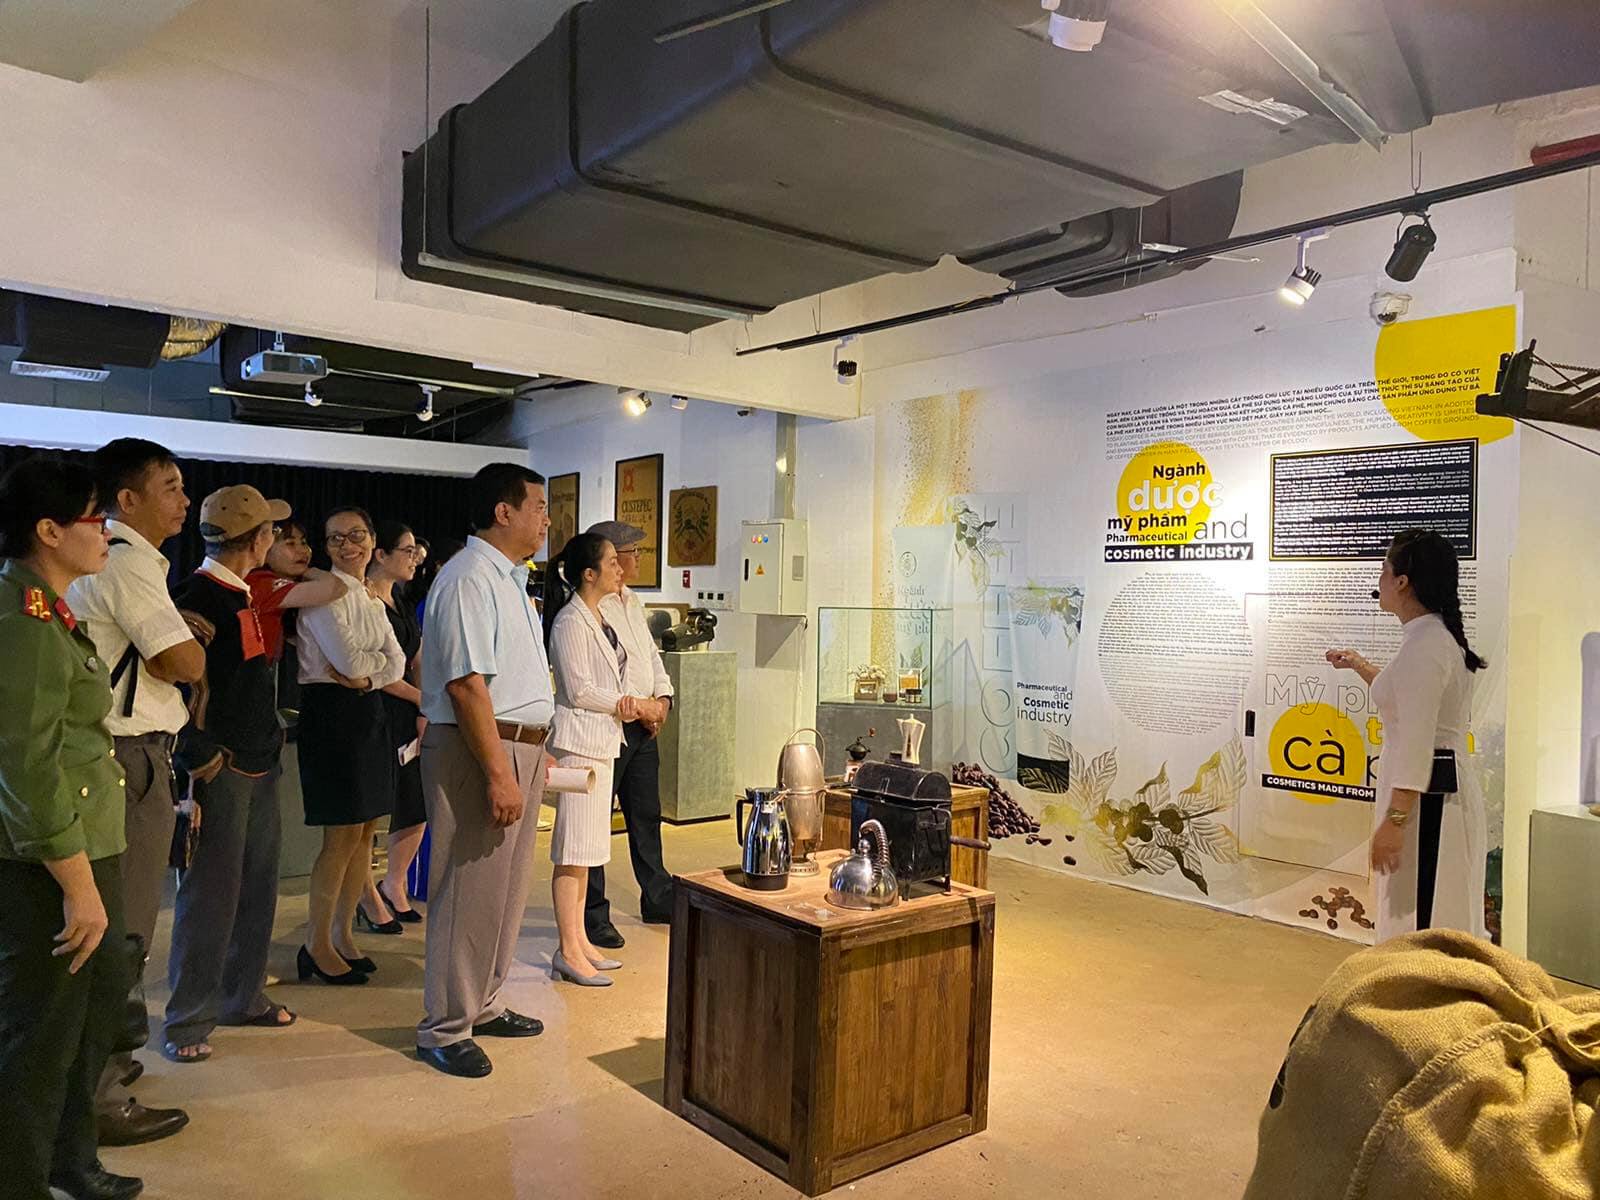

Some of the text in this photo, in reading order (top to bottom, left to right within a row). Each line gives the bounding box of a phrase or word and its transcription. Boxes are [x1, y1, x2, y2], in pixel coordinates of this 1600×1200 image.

[1444, 399, 1475, 407] ADDITIO
[1444, 406, 1475, 415] LIMITLES
[1153, 463, 1206, 480] Ngành
[1128, 479, 1225, 515] dược
[1106, 513, 1248, 543] Pharmaceutical and
[1107, 512, 1188, 531] mỹ phẩm
[1104, 546, 1251, 560] cosmetic industry
[1016, 682, 1068, 692] Pharmaceutical
[1054, 690, 1073, 700] and
[1265, 673, 1326, 716] Mỹ
[1024, 697, 1070, 710] Cosmetic
[1016, 706, 1072, 726] industry
[1283, 729, 1346, 776] cà
[1266, 776, 1374, 798] COSMETICS MADE FROM
